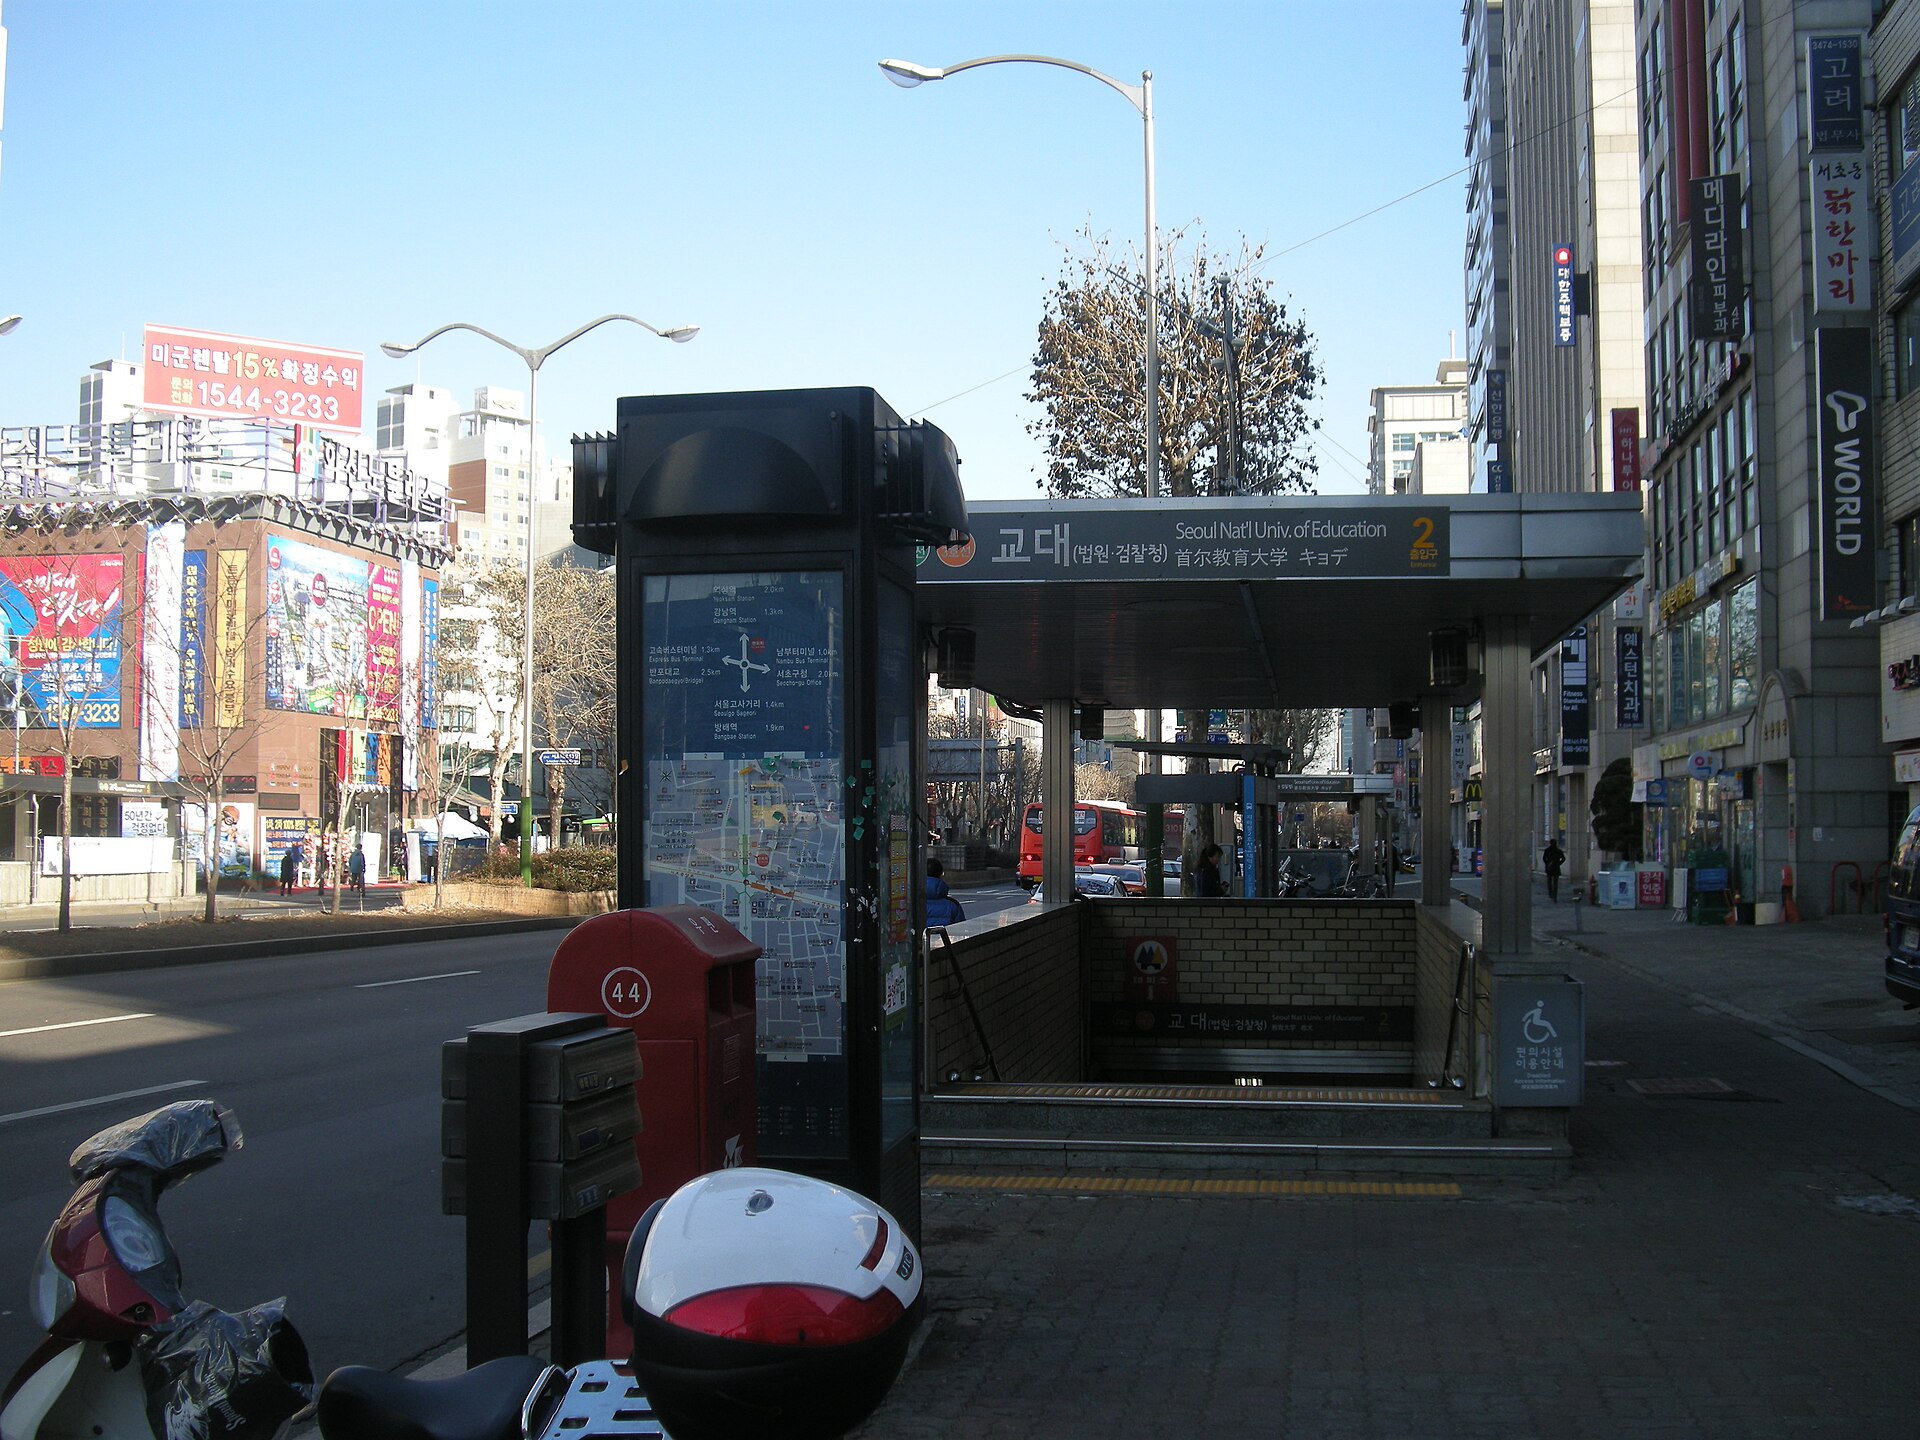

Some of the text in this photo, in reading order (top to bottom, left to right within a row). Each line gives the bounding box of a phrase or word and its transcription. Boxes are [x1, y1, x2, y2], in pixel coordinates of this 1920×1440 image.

[1815, 128, 1861, 142] 법무사
[1816, 162, 1862, 180] 서초동
[1823, 187, 1859, 304] 닭한마리
[1702, 179, 1728, 333] 메디라인 피부과
[1557, 267, 1572, 342] 대한주택보증
[151, 343, 358, 391] 미군렌탈 15% 확정수익
[197, 381, 340, 421] 1544-3233
[1621, 437, 1634, 491] 하나투어
[1834, 438, 1861, 556] WORLD
[1175, 519, 1387, 540] Seoul Nat'l Univ. of Education
[1412, 517, 1435, 548] 2
[991, 522, 1070, 567] 교대
[1174, 547, 1349, 568] 首尔教育大学 キョデ
[764, 586, 784, 594] 2.0km
[713, 607, 784, 616] 강남역 1.3km
[649, 646, 720, 655] 고속버스터미널 1.3km
[776, 647, 838, 656] 남부터미널 1.0km
[649, 667, 721, 677] 반포대교 2.5km
[776, 669, 808, 678] 서초구청
[1624, 632, 1641, 713] 웨스턴치과
[714, 699, 761, 709] 서울고사거리
[714, 723, 738, 732] 방배역
[124, 811, 153, 822] 50년간
[612, 982, 641, 1003] 44
[1378, 1011, 1390, 1027] 2
[1515, 1058, 1564, 1070] 이용안내
